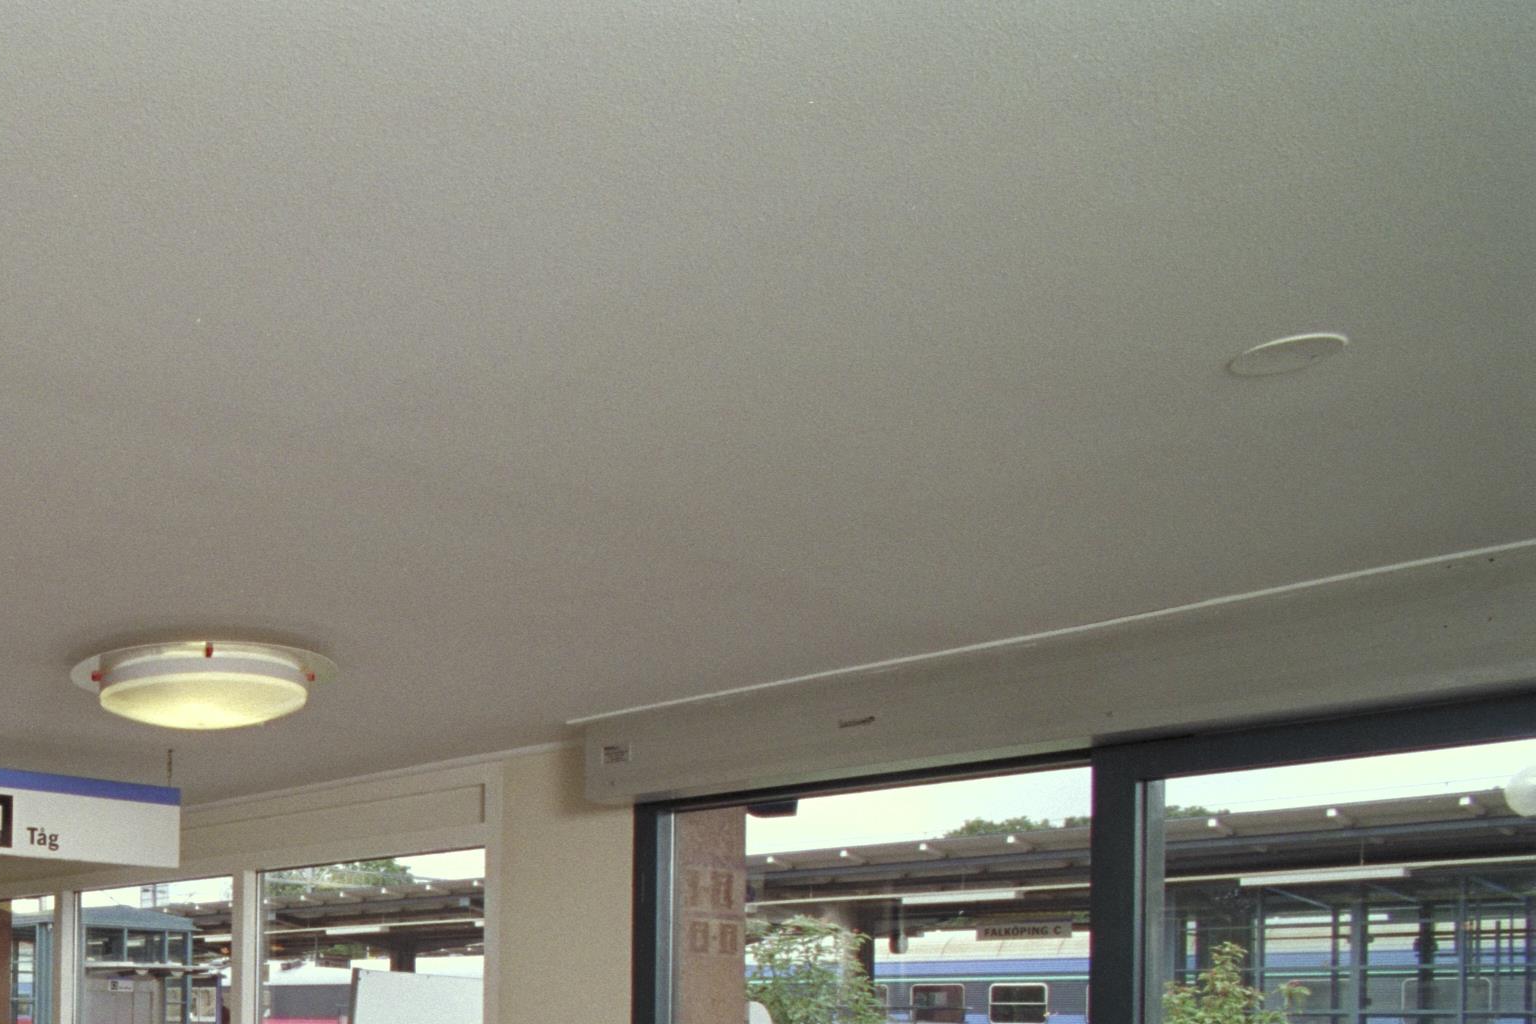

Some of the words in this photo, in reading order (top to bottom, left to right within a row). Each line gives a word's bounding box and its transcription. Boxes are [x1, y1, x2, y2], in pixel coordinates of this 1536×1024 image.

[26, 826, 60, 852] Tåg
[984, 925, 1048, 937] FALKÖPING
[1052, 925, 1062, 935] C
